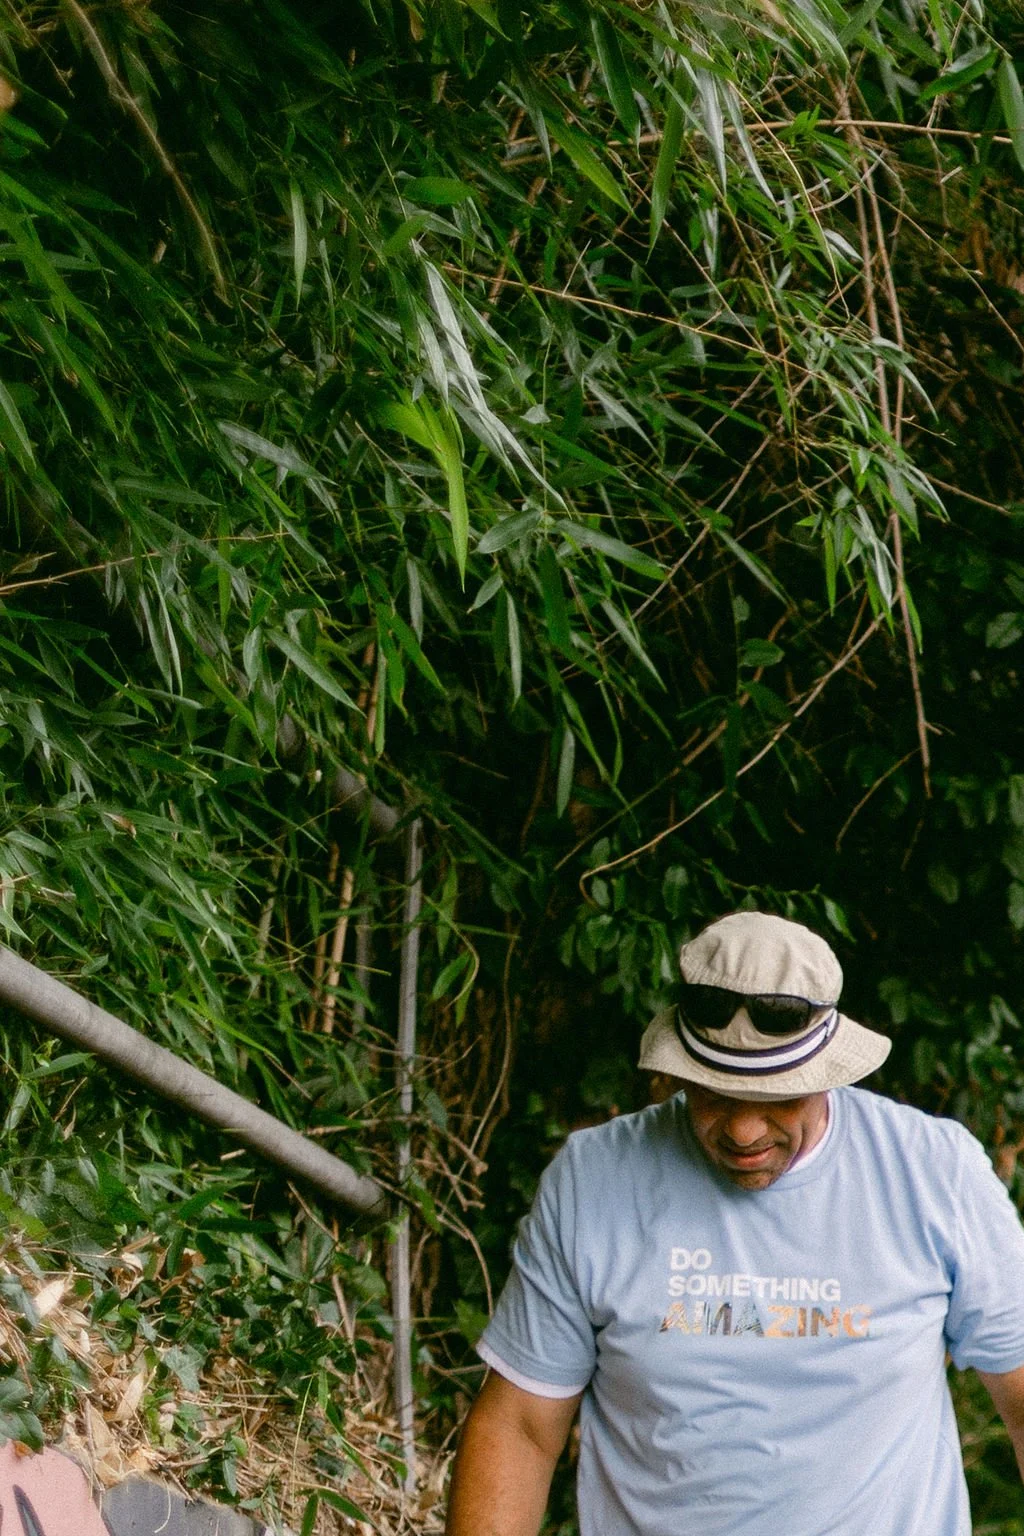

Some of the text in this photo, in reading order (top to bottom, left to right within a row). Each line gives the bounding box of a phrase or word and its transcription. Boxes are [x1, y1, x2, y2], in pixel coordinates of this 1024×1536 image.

[670, 1247, 712, 1271] DO
[667, 1273, 841, 1302] SOMETHING
[659, 1300, 873, 1338] AMAZING
